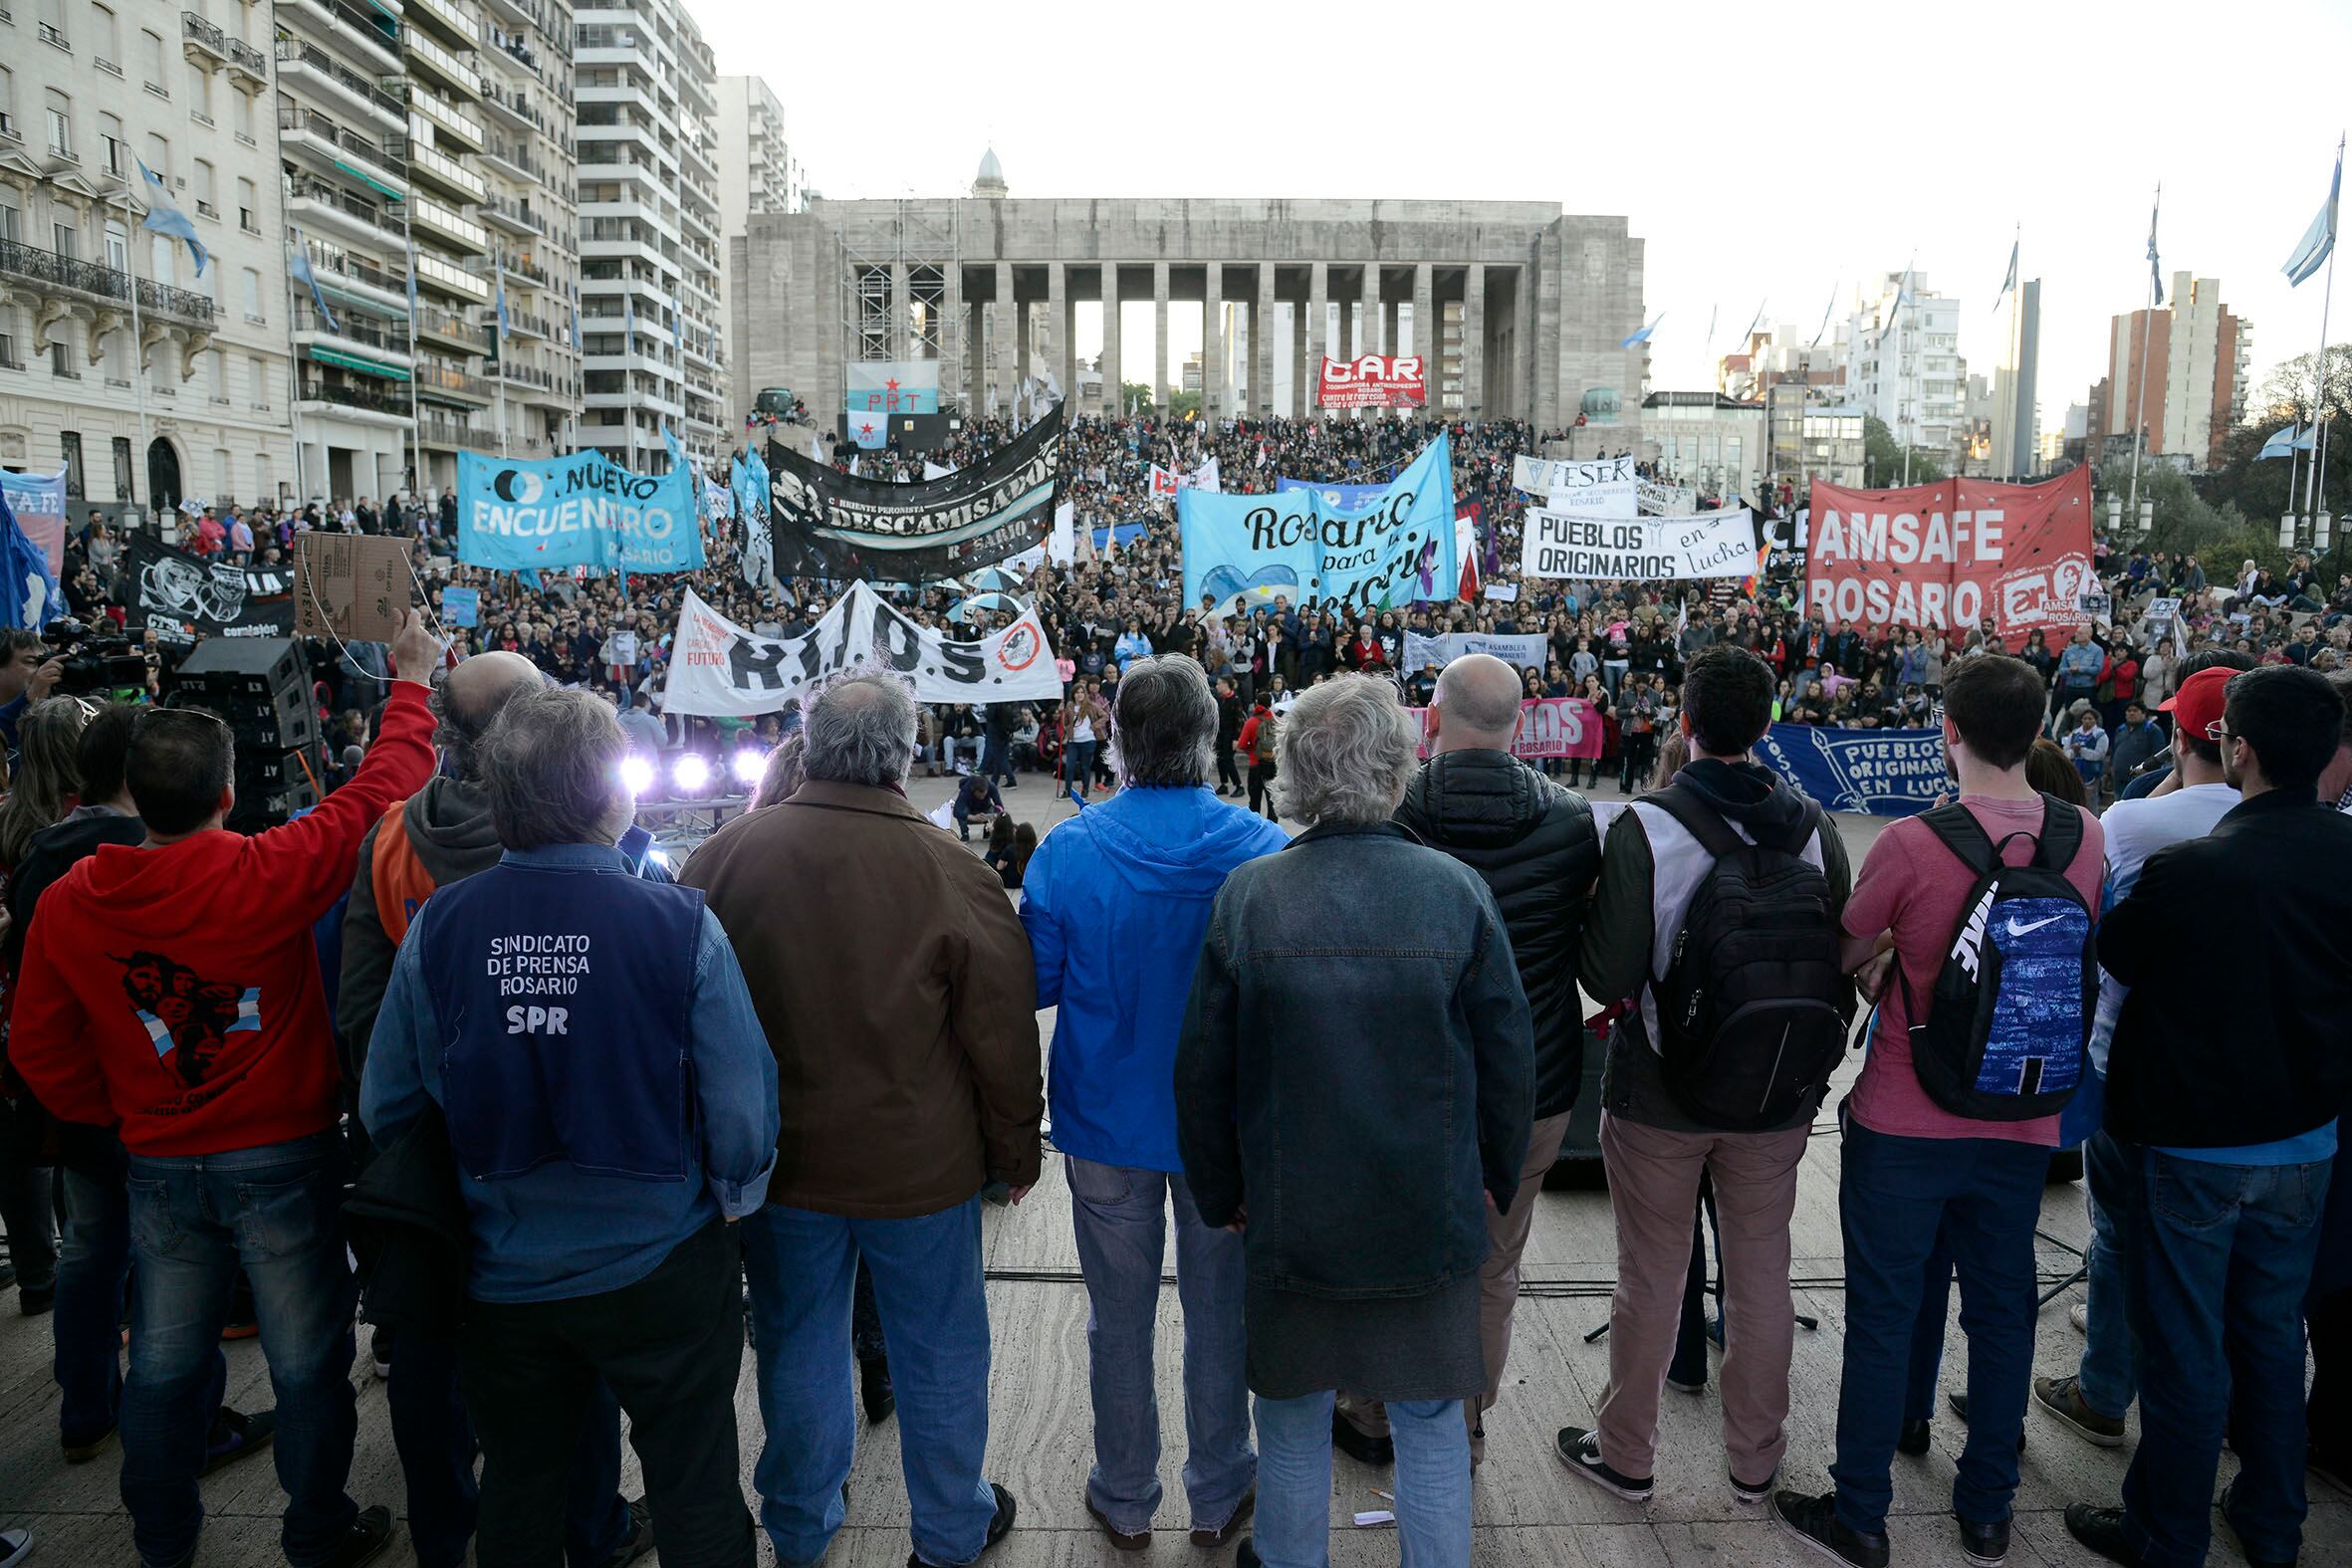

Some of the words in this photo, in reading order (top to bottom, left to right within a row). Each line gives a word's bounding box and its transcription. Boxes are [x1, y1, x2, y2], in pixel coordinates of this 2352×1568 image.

[1324, 354, 1423, 382] C.A.R.
[868, 393, 921, 412] PRT
[567, 463, 658, 500] NUEVO
[829, 446, 1058, 536] DESCAMISADOS
[41, 491, 60, 514] FE
[877, 504, 925, 515] PERONISTA
[1570, 498, 1604, 507] ROSARIO
[472, 498, 673, 540] ENCUENTRO
[1245, 491, 1418, 551] Rosario
[1539, 517, 1643, 550] PUEBLOS
[1680, 529, 1707, 548] en
[1813, 510, 2005, 563] AMSAFE
[1321, 547, 1378, 572] para
[1537, 548, 1676, 578] ORIGINARIOS
[1686, 541, 1751, 574] lucha
[246, 572, 283, 595] LA
[1811, 577, 1983, 630] ROSARIO
[2043, 600, 2075, 612] AMSA
[687, 652, 726, 666] FUTURO
[1520, 740, 1562, 754] ROSARIO
[1845, 739, 1944, 764] PUEBLOS
[1848, 757, 1947, 780] ORIGINAR
[1859, 779, 1891, 794] EN
[1907, 777, 1960, 795] LUCH
[1950, 880, 1999, 984] NIKE
[491, 935, 590, 956] SINDICATO
[487, 957, 512, 976] DE
[516, 955, 590, 974] PRENSA
[500, 977, 578, 997] ROSARIO
[506, 1005, 569, 1035] SPR
